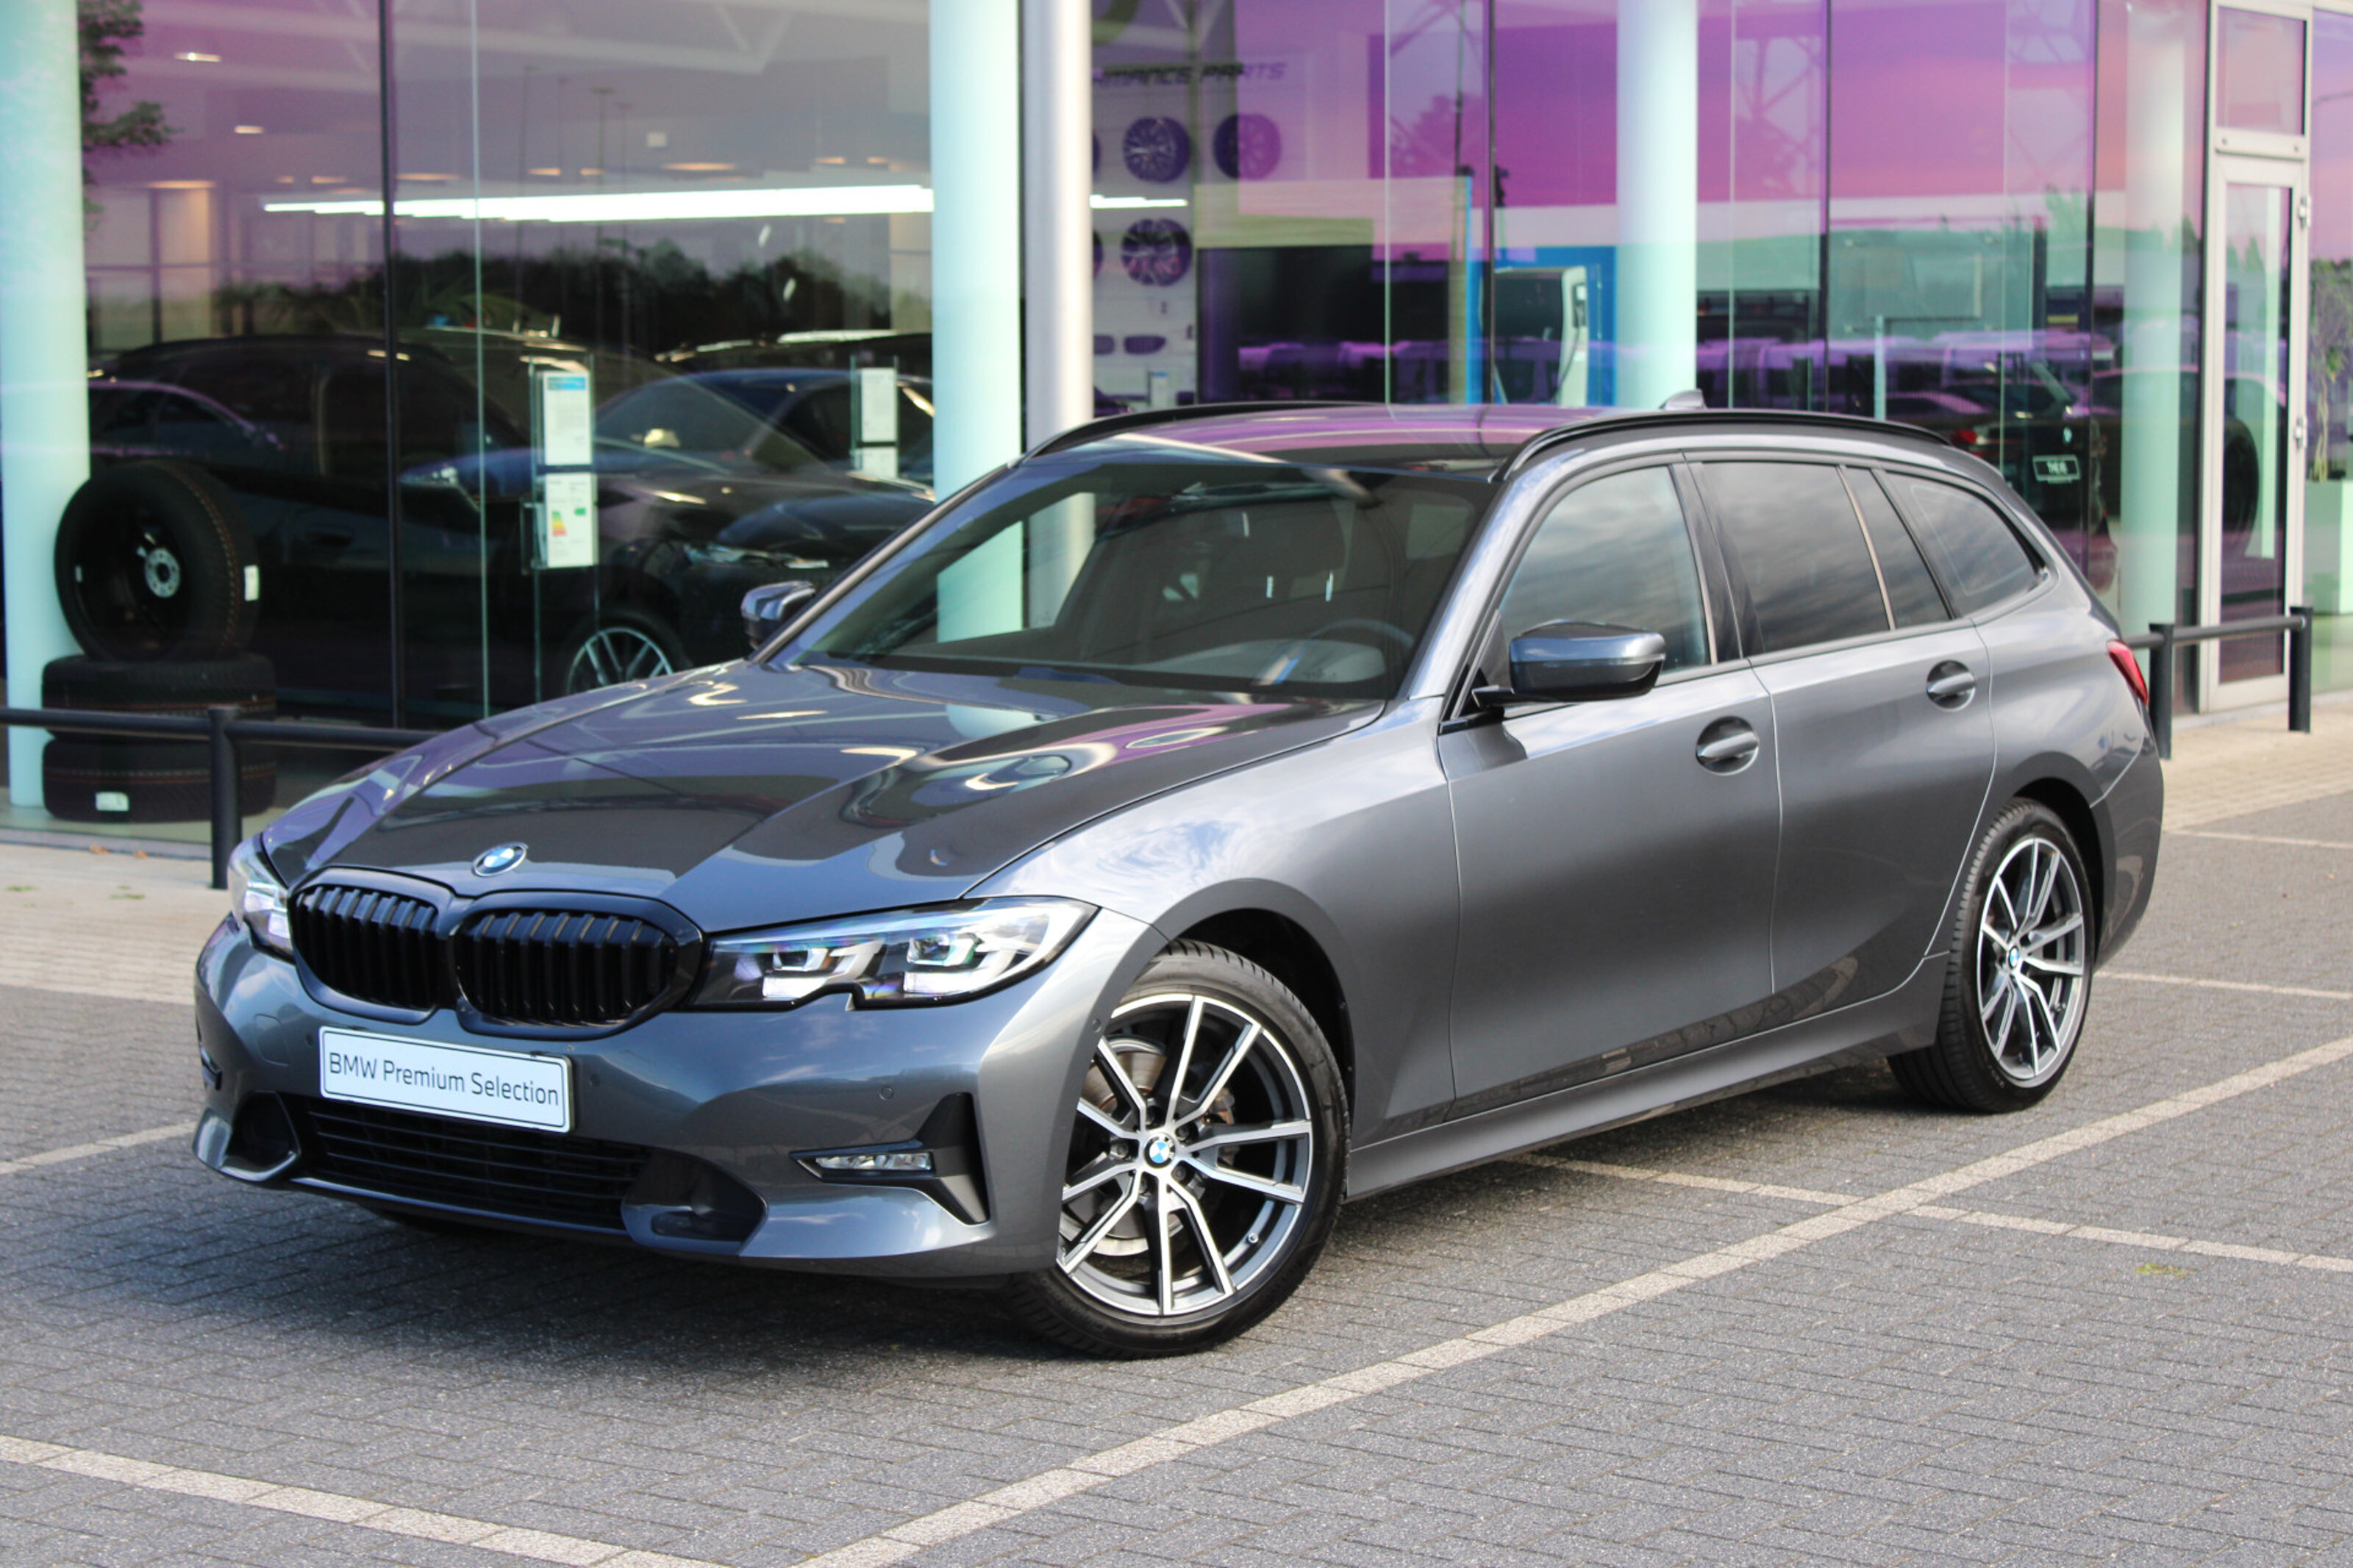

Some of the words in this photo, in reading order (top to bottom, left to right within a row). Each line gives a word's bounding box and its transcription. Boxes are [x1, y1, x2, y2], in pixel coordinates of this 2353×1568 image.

[329, 1052, 377, 1079] BMW
[383, 1059, 465, 1092] Premium
[471, 1072, 559, 1106] Selection
